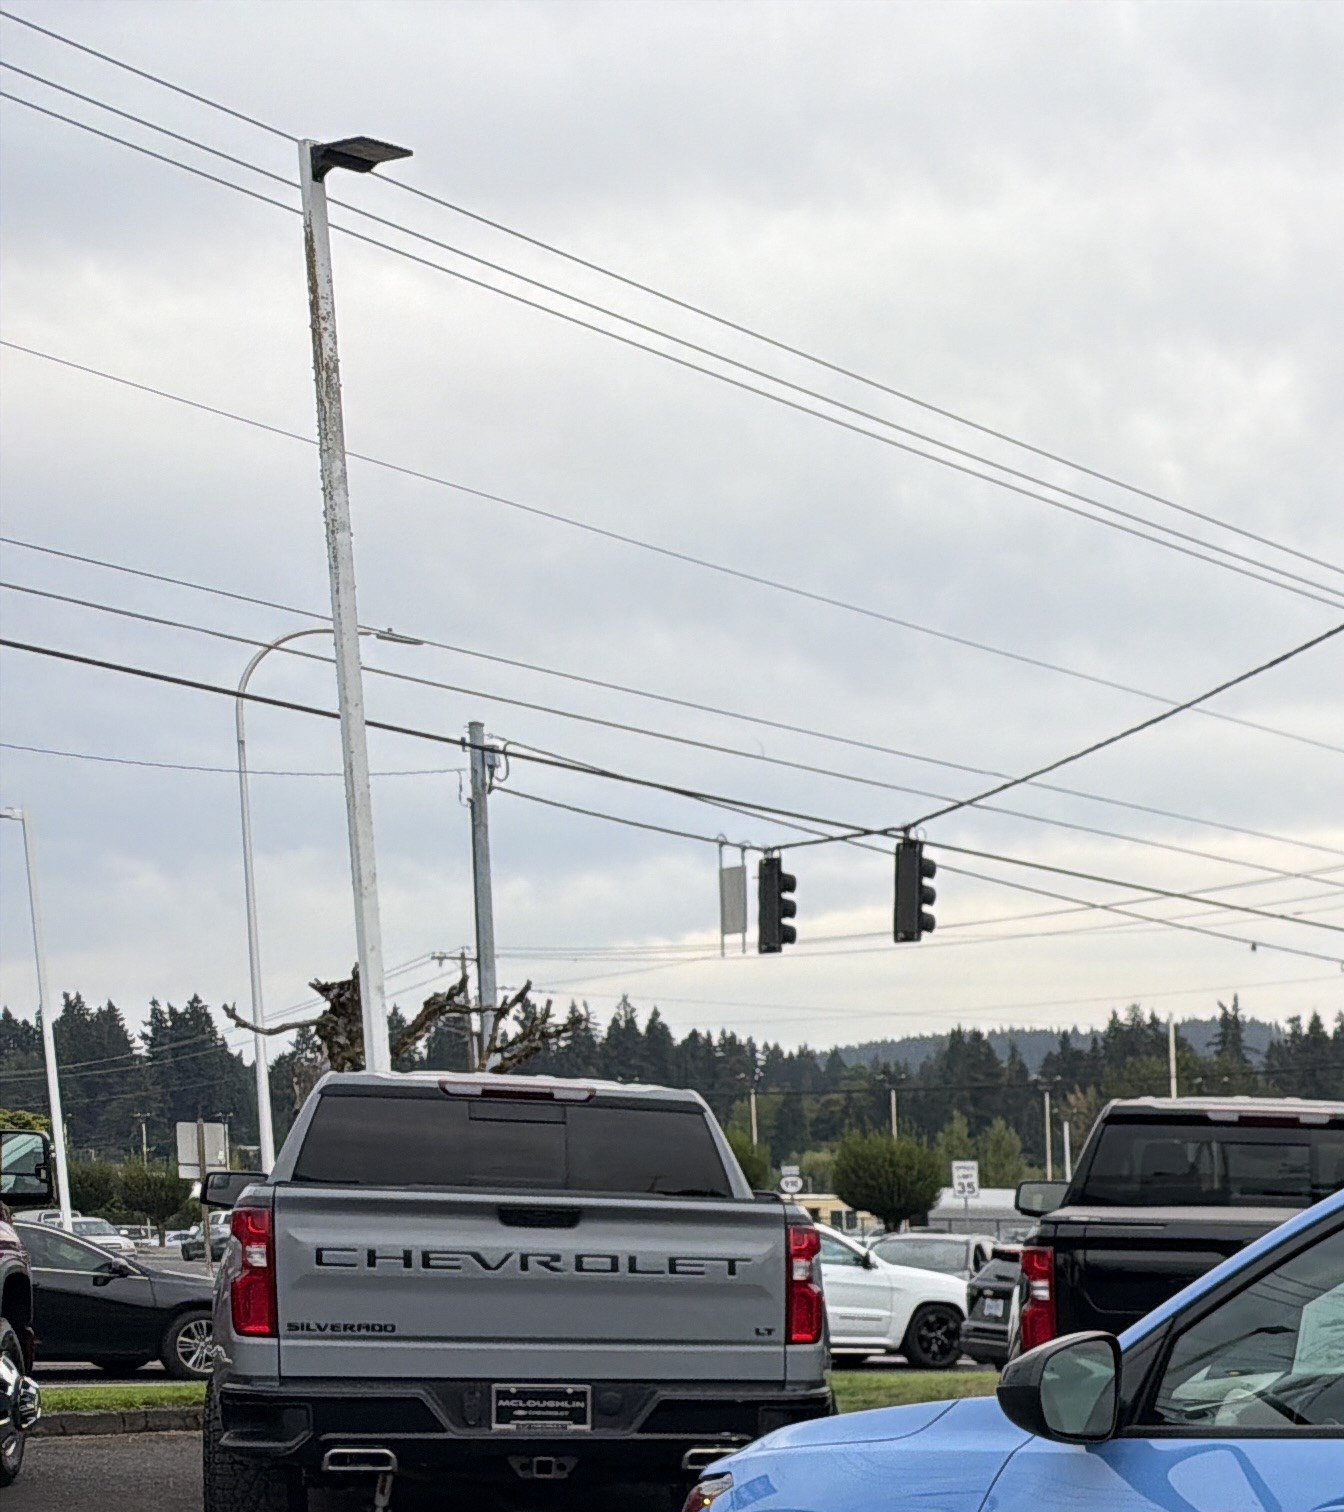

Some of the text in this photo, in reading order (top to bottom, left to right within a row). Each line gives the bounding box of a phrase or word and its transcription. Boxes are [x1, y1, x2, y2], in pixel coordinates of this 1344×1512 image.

[957, 1181, 976, 1194] 35
[315, 1247, 752, 1276] CHEVROLET
[286, 1322, 397, 1334] SILVERADO
[754, 1326, 775, 1337] LT
